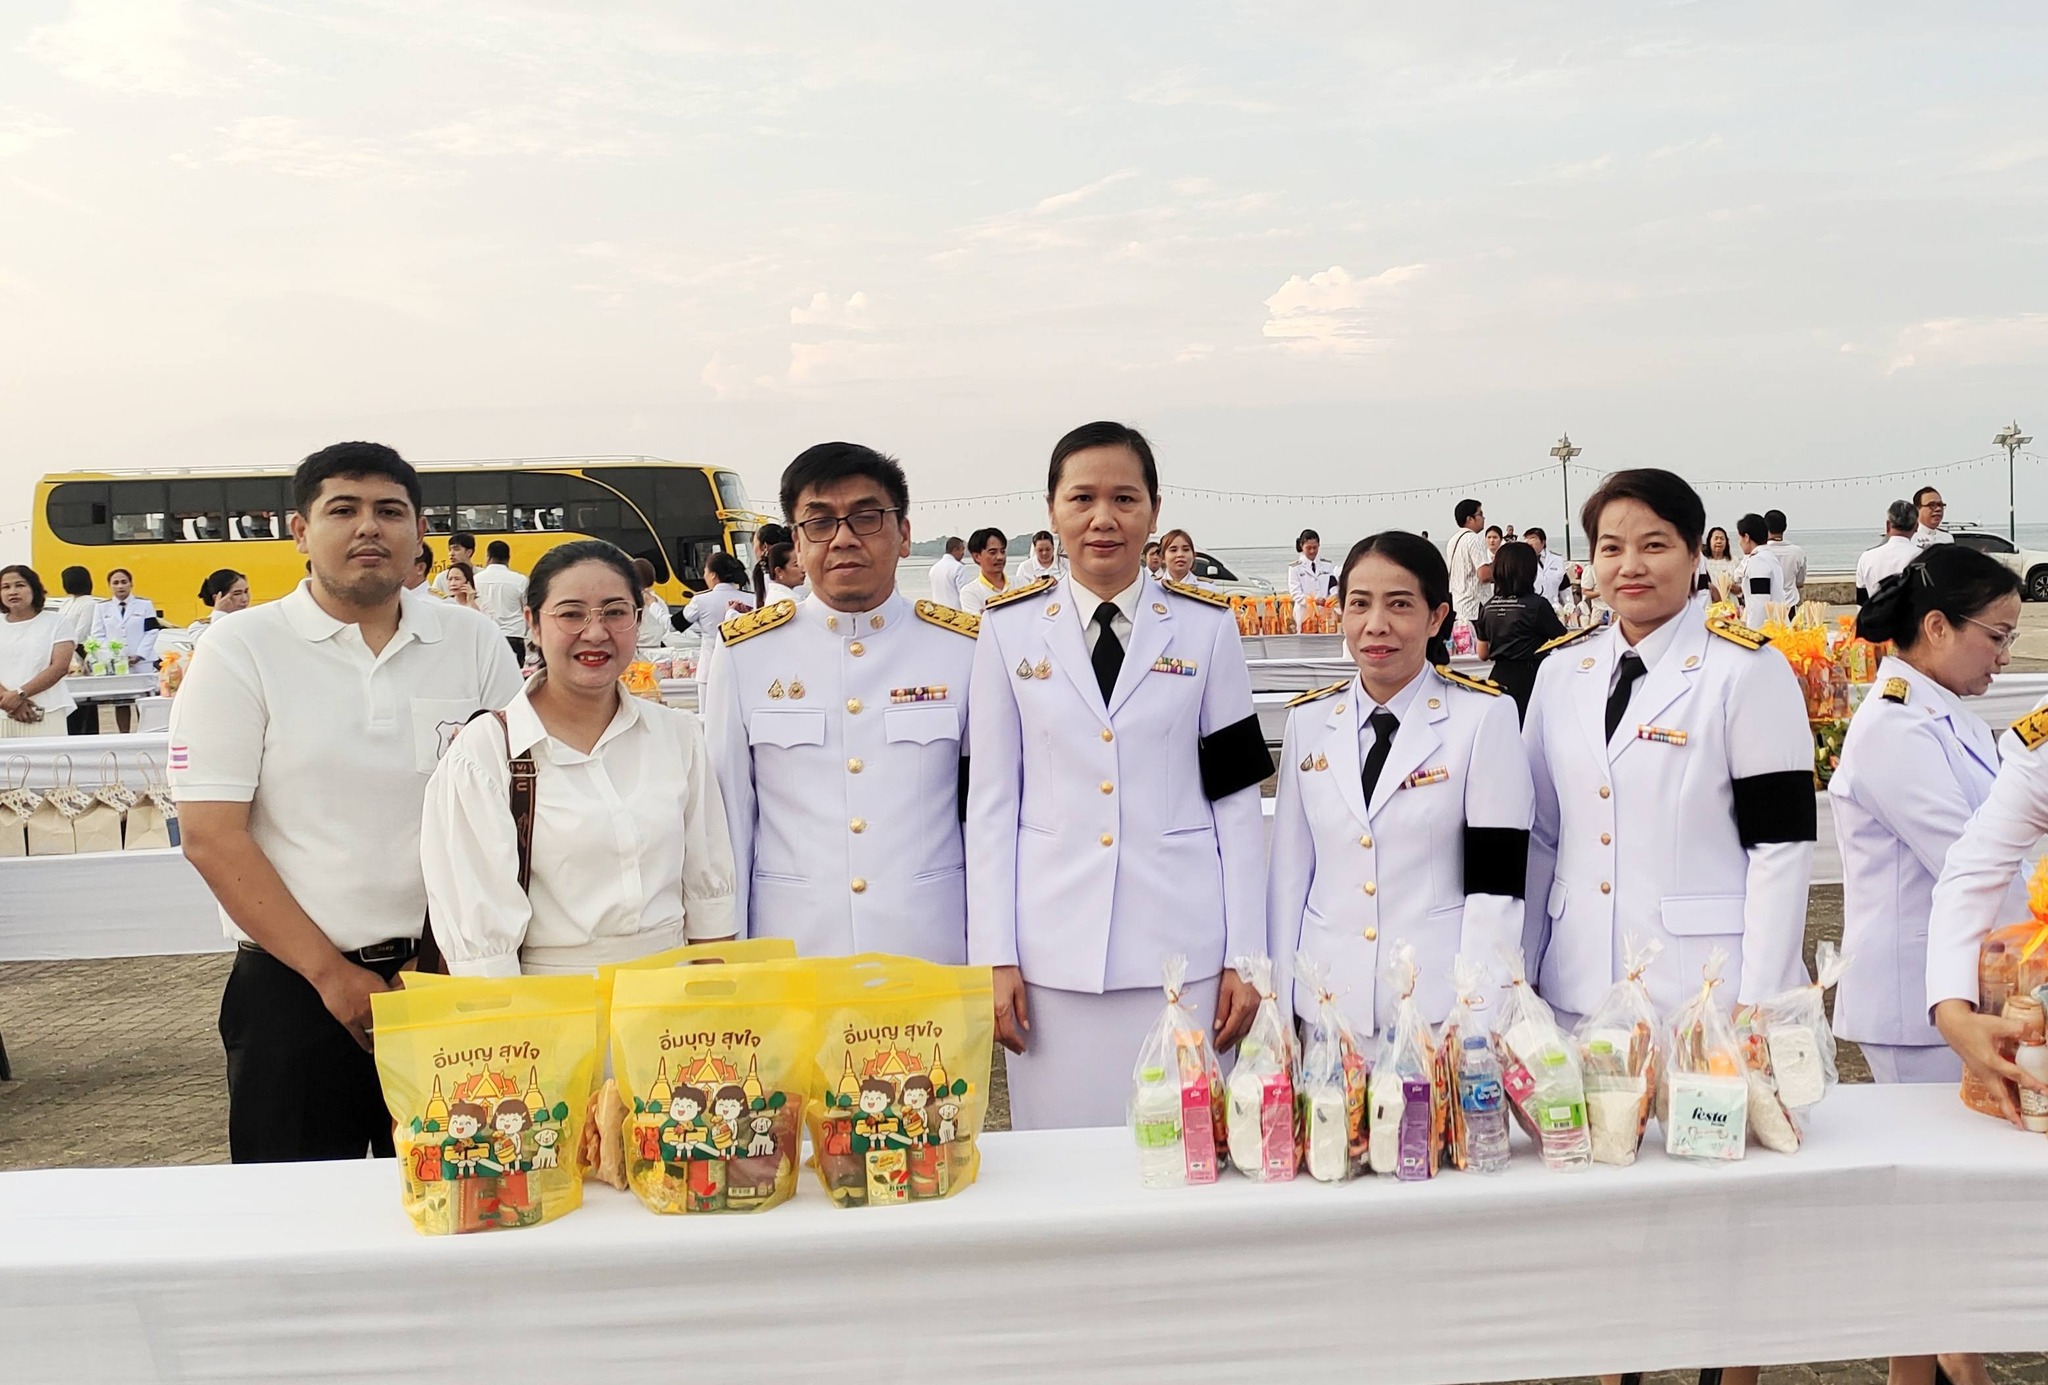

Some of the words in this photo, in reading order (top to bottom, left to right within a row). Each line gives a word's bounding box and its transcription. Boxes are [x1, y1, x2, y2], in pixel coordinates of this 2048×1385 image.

[659, 1029, 716, 1051] อิ่มบุญ
[721, 1028, 762, 1051] สุขใจ
[843, 1023, 899, 1045] อิ่มบุญ
[904, 1020, 943, 1042] สุขใจ
[433, 1047, 493, 1069] อิ่มบุญ
[499, 1041, 541, 1064] สุขใจ
[1692, 1106, 1728, 1122] festa
